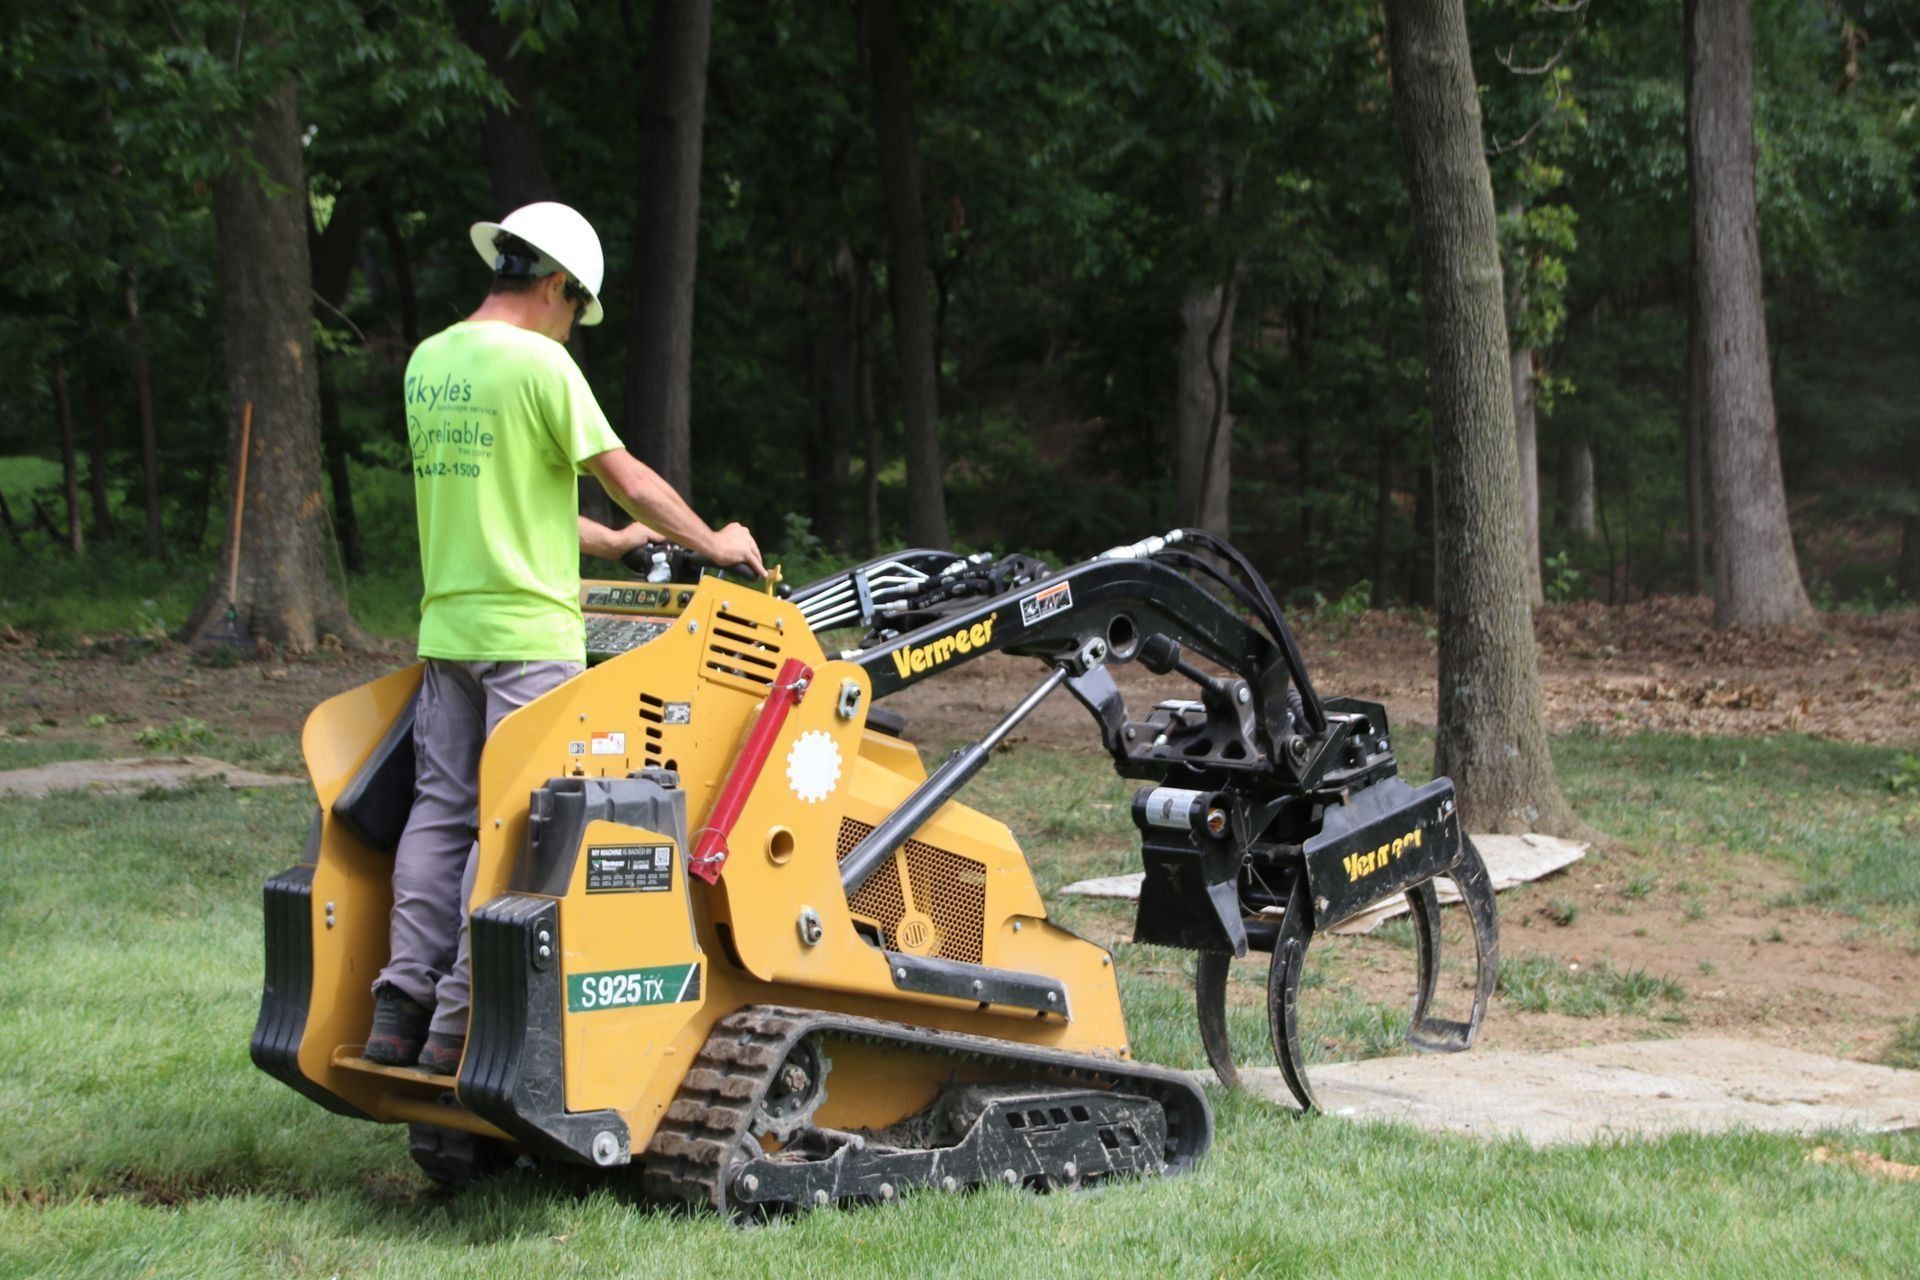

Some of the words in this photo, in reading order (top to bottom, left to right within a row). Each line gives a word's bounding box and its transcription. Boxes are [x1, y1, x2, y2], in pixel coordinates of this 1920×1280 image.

[416, 373, 472, 412] kyle's
[428, 420, 494, 447] reliable
[891, 618, 997, 679] Vermeer
